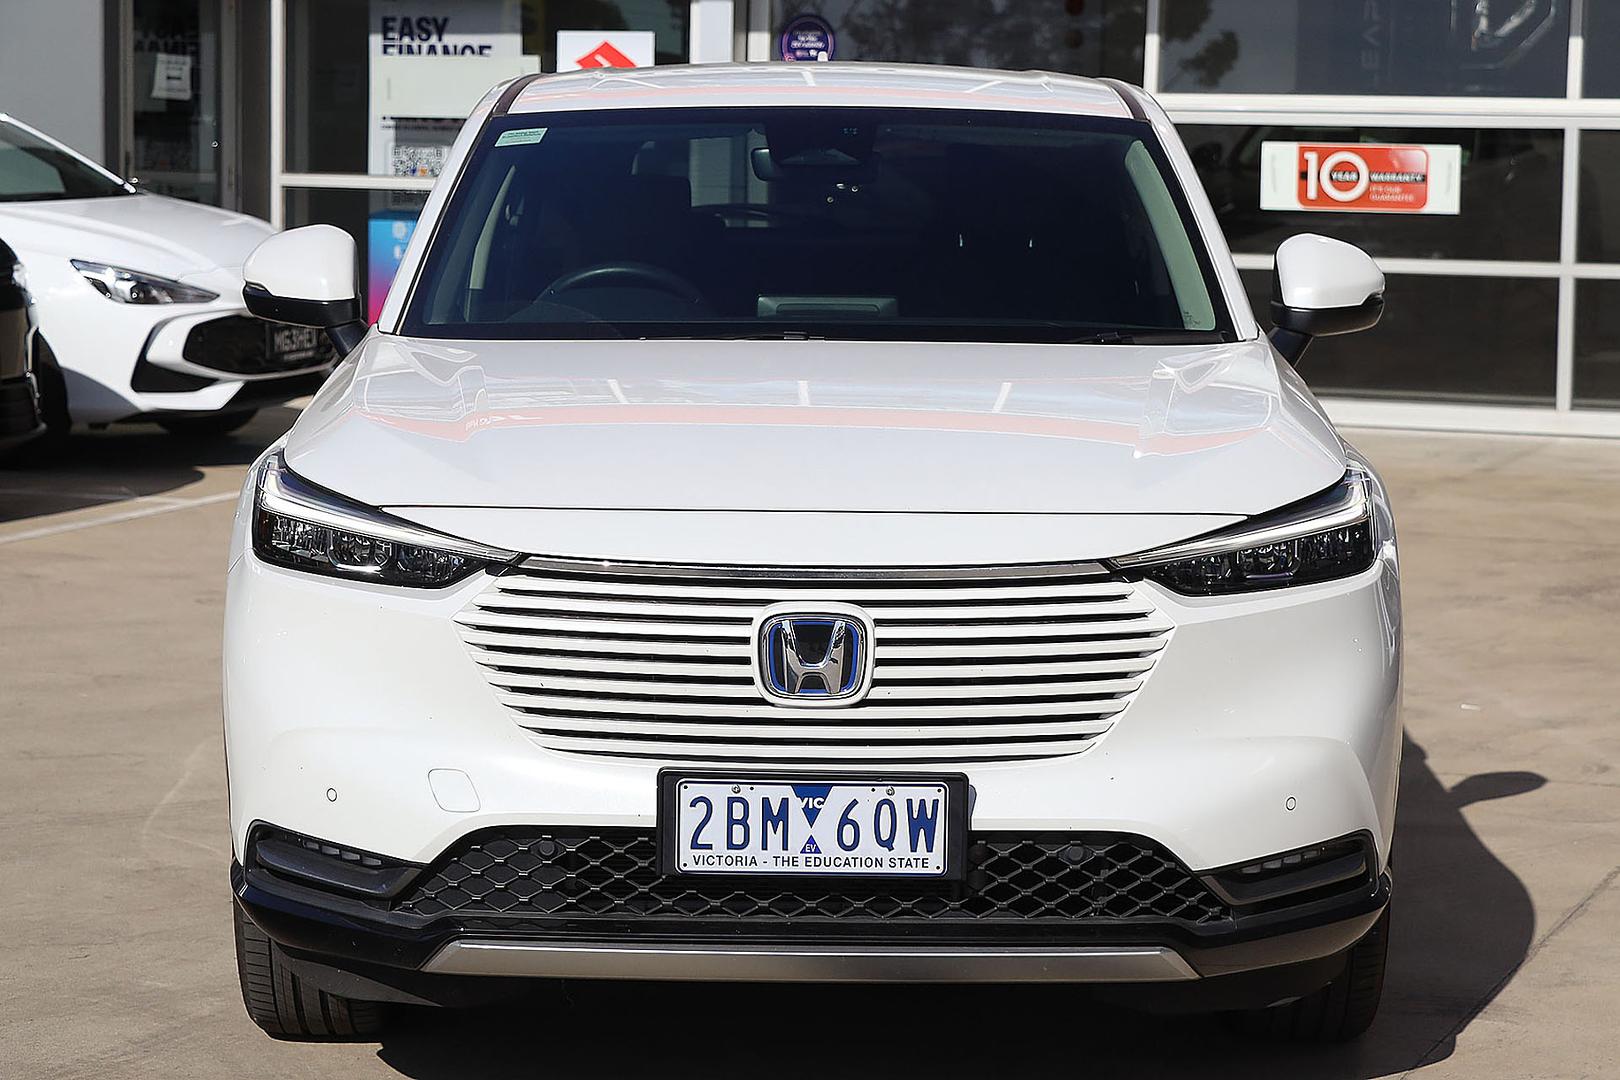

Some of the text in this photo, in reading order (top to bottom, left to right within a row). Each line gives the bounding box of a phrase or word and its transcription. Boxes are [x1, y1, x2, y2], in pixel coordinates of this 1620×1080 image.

[382, 16, 449, 41] EASY
[1303, 151, 1370, 202] 10
[1331, 171, 1423, 183] YEAR WARRANTY
[799, 797, 825, 809] VIC
[690, 796, 940, 853] 2BM 6QW
[805, 843, 817, 853] EV
[693, 855, 758, 867] VICTORIA
[773, 856, 799, 867] THE
[804, 857, 884, 868] EDUCATION
[888, 858, 929, 868] STATE
